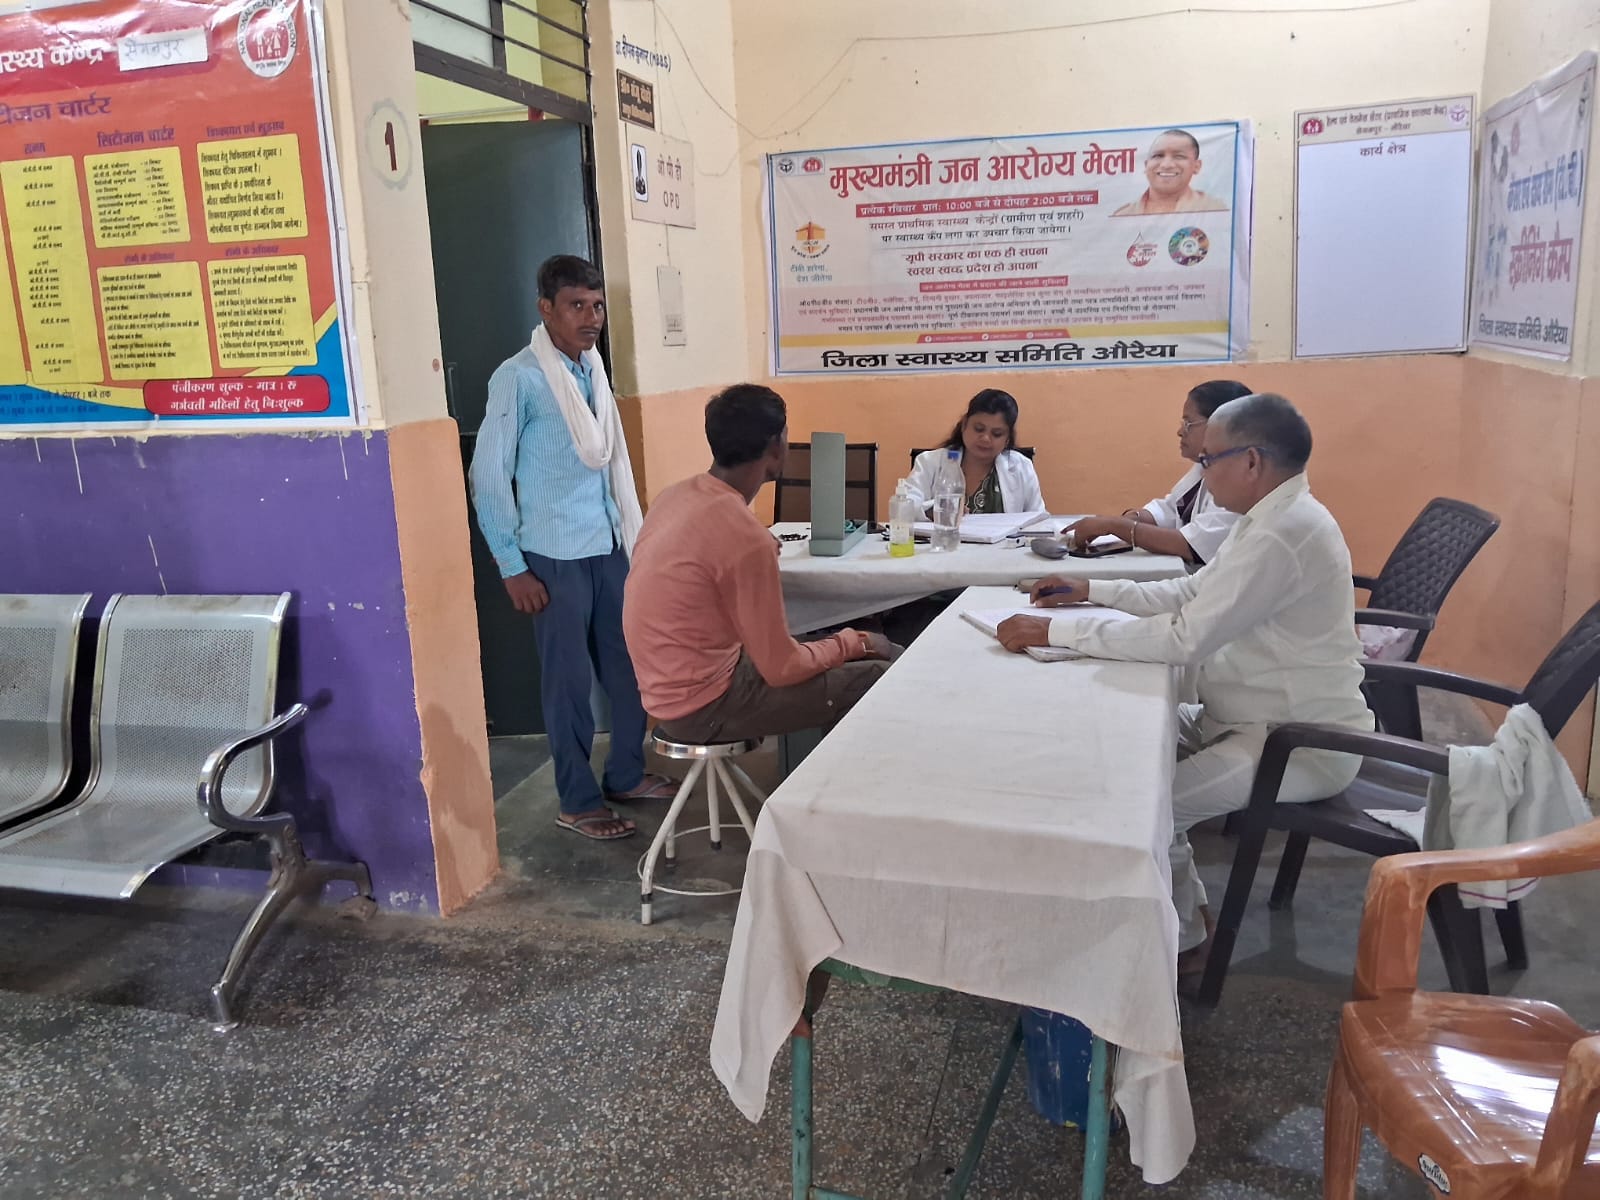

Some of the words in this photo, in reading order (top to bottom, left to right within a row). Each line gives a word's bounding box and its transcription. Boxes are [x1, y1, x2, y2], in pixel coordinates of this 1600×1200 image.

[57, 91, 112, 117] चार्टर
[384, 121, 398, 171] 1
[1360, 141, 1383, 156] कार्य
[1387, 141, 1407, 155] क्षेत्र
[829, 153, 933, 198] मुख्यमंत्री
[938, 157, 981, 184] जन
[987, 147, 1077, 182] आरोग्य
[1083, 143, 1138, 176] मेला
[945, 201, 972, 211] 10:00
[1032, 195, 1055, 205] 2:00
[898, 218, 935, 230] प्राथमिक
[937, 217, 969, 228] स्वास्थ्य
[1056, 209, 1085, 222] शहरी)
[881, 233, 893, 243] पर
[945, 229, 963, 239] लगा
[982, 227, 1009, 239] उपचार
[1012, 225, 1035, 236] किया
[904, 251, 925, 264] यूपी
[928, 249, 964, 262] सरकार
[966, 249, 981, 260] का
[984, 248, 1002, 259] एक
[1003, 246, 1016, 258] ही
[1019, 246, 1048, 257] सपना
[966, 263, 991, 275] प्रदेश
[1008, 261, 1038, 272] अपना
[1479, 313, 1494, 336] जिला
[1494, 318, 1517, 340] स्वास्थ्य
[1517, 316, 1542, 341] समिति
[821, 350, 889, 368] जिला
[895, 350, 989, 366] स्वास्थ्य
[995, 343, 1086, 363] समिति
[1091, 340, 1178, 360] औरैया
[171, 380, 215, 393] पंजीकरण
[219, 380, 244, 397] शुल्क
[256, 380, 276, 391] मात्र
[170, 397, 206, 411] गर्भवती
[243, 396, 261, 413] हेतु
